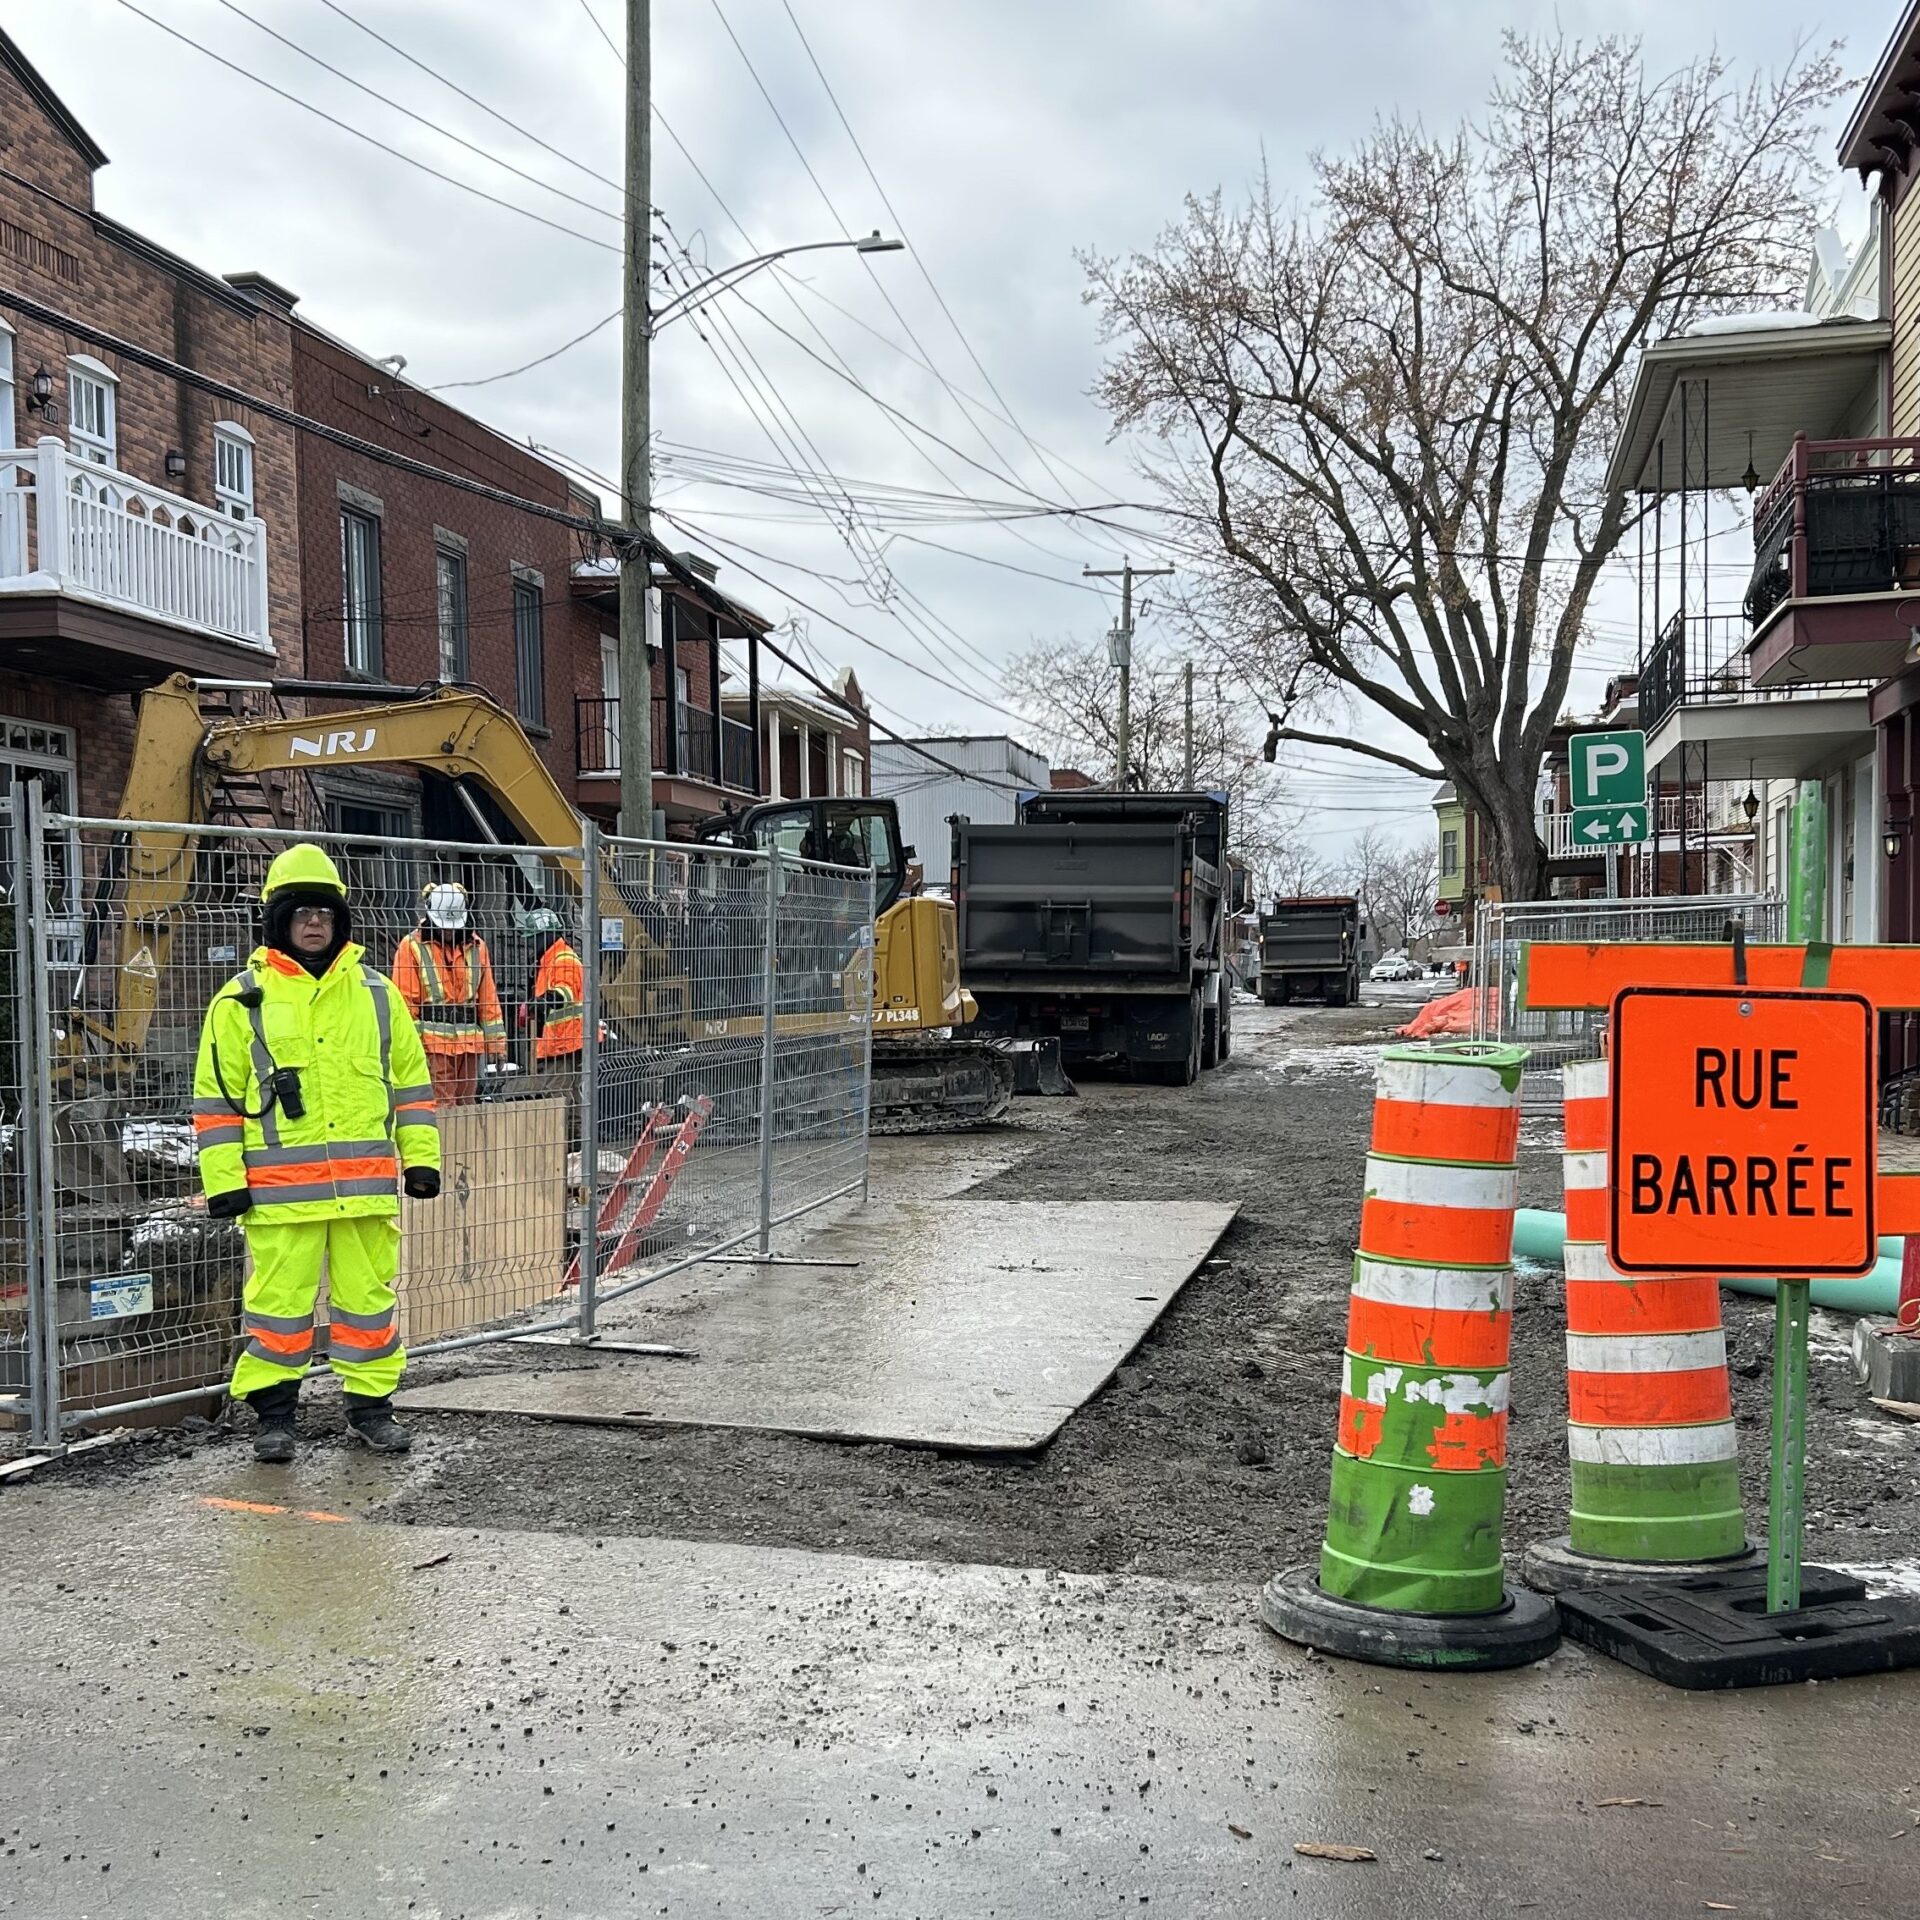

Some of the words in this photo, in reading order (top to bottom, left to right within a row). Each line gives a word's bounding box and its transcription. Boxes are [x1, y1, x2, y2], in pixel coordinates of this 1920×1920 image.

[289, 728, 377, 759] NRJ
[1586, 743, 1629, 796] P
[886, 1009, 919, 1023] PL348
[1695, 1047, 1799, 1110] RUE
[1631, 1143, 1854, 1217] BARRÉE
